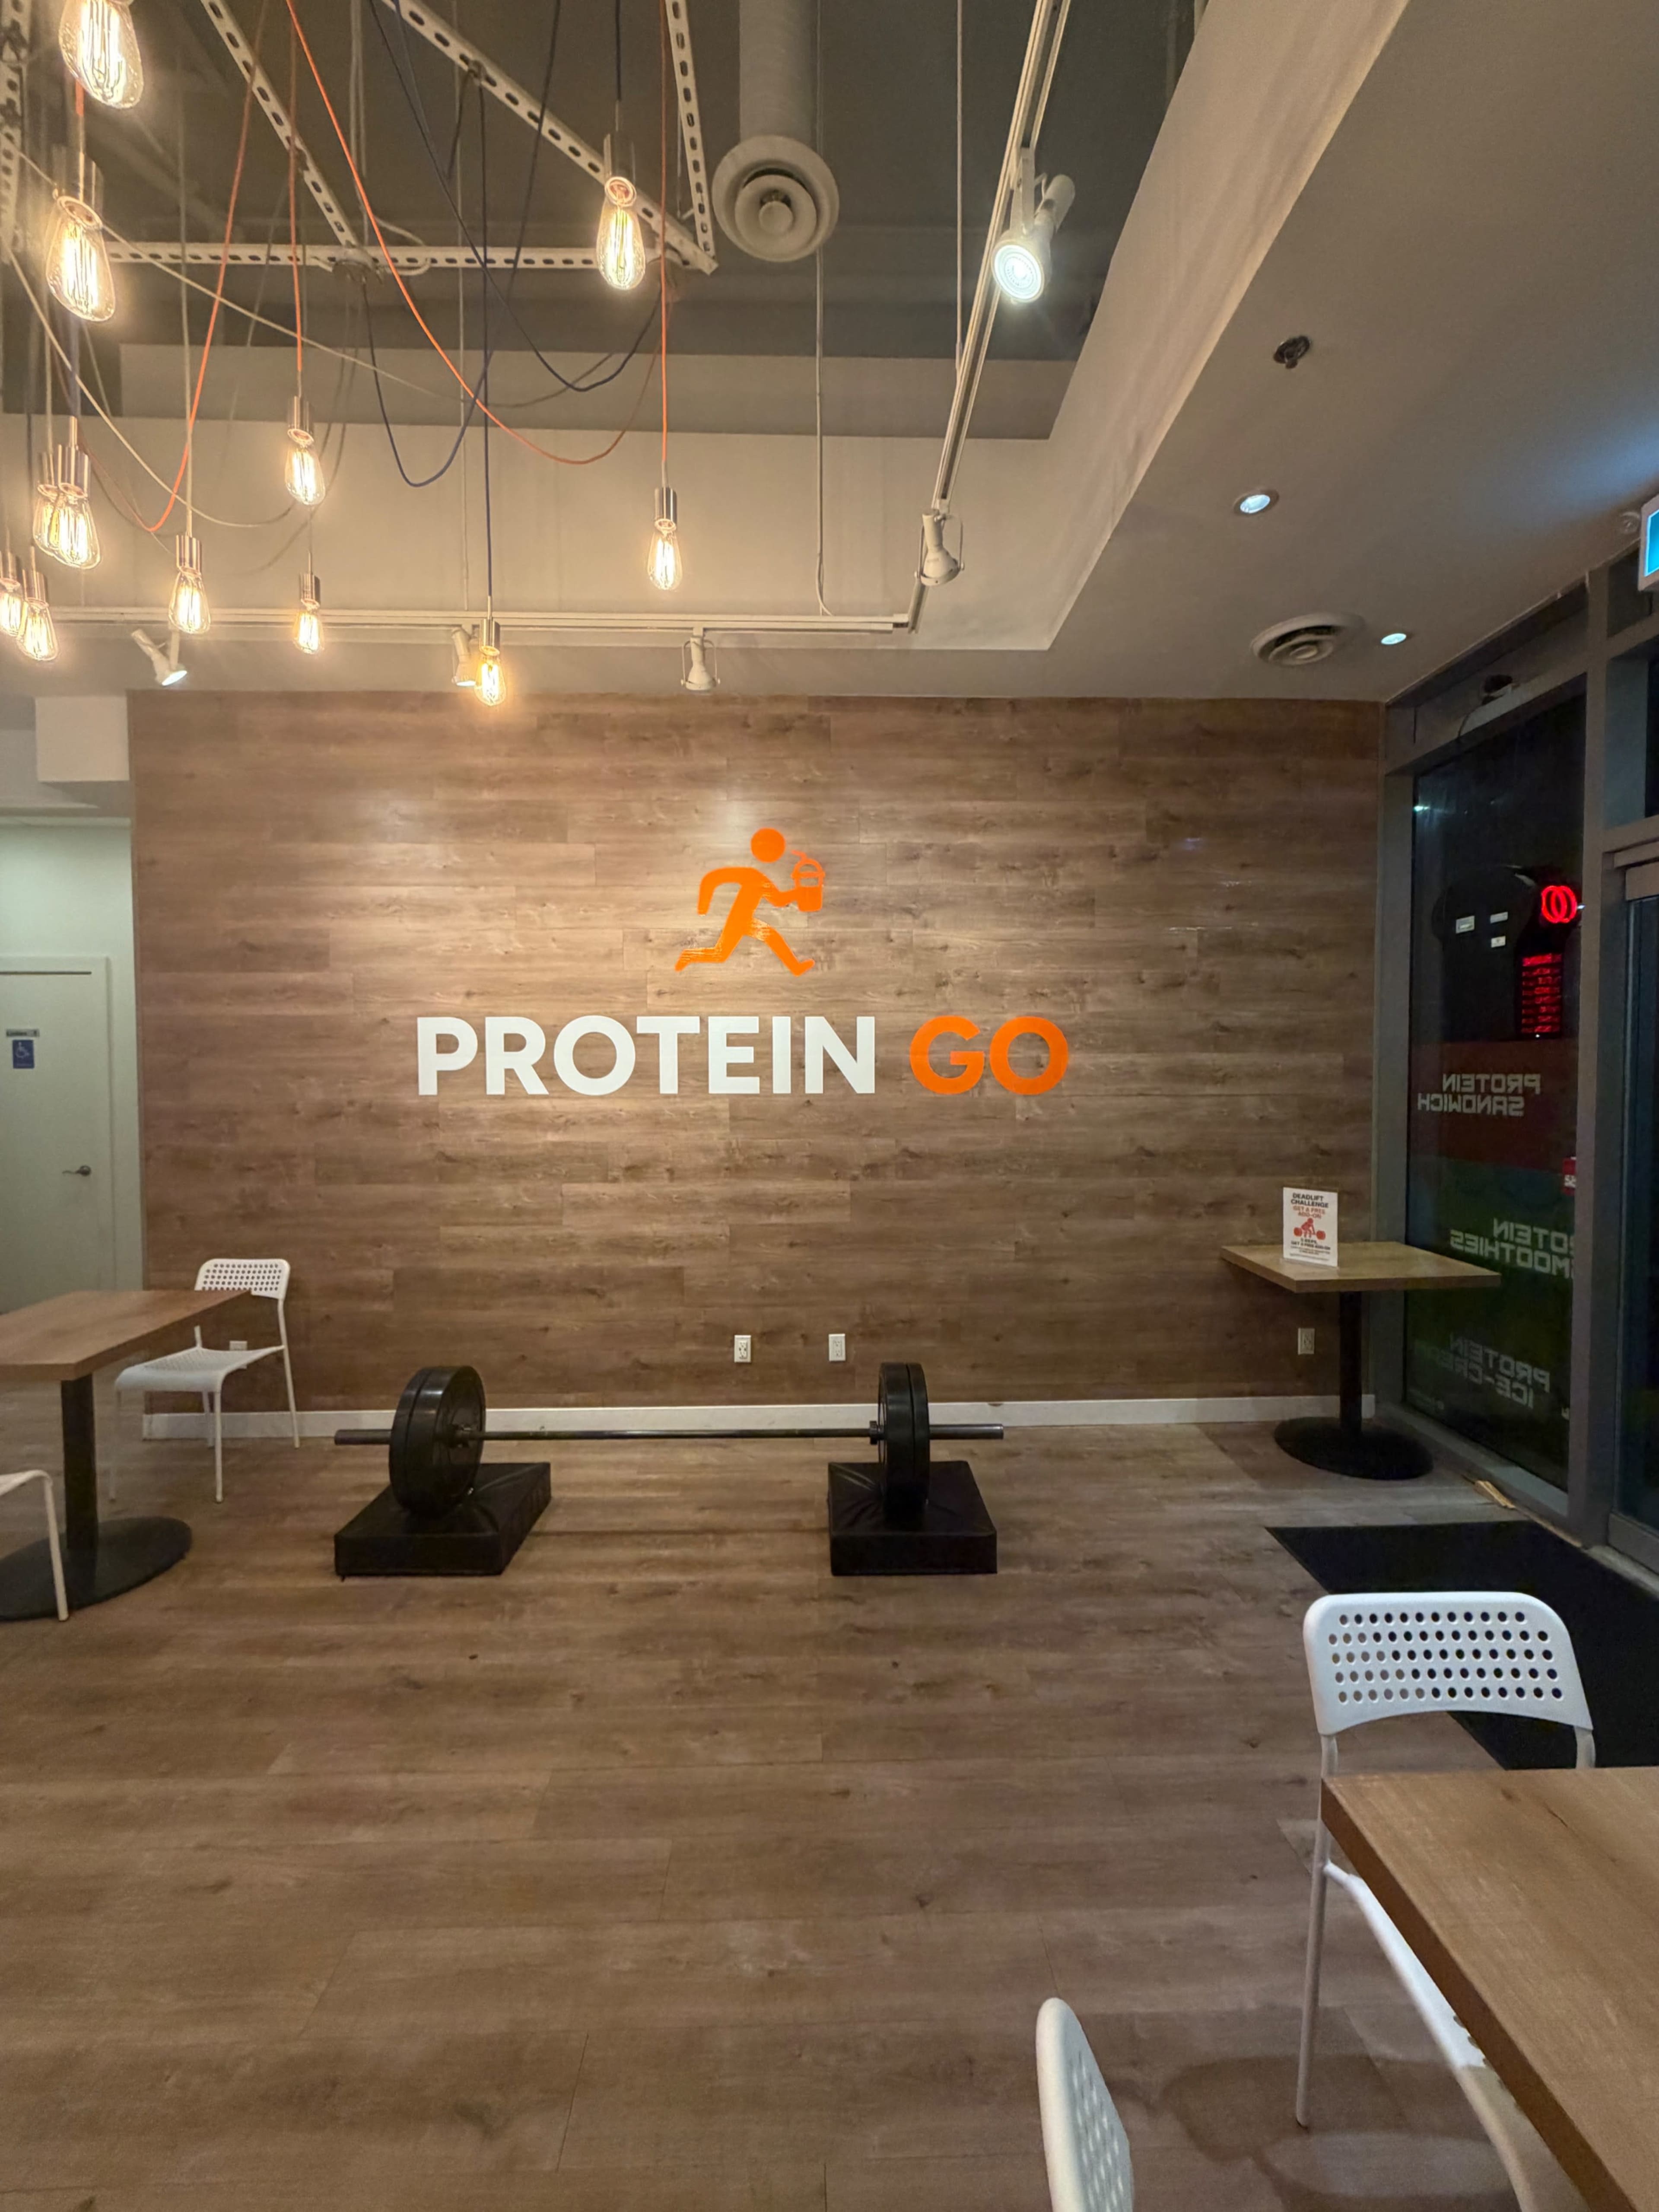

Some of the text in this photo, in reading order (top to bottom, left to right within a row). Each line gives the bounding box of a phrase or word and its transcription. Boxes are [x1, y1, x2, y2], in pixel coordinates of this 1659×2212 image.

[416, 1015, 1069, 1096] PROTEIN GO
[1293, 1193, 1324, 1201] DEADLIFT
[1291, 1199, 1328, 1208] CHALLENGE
